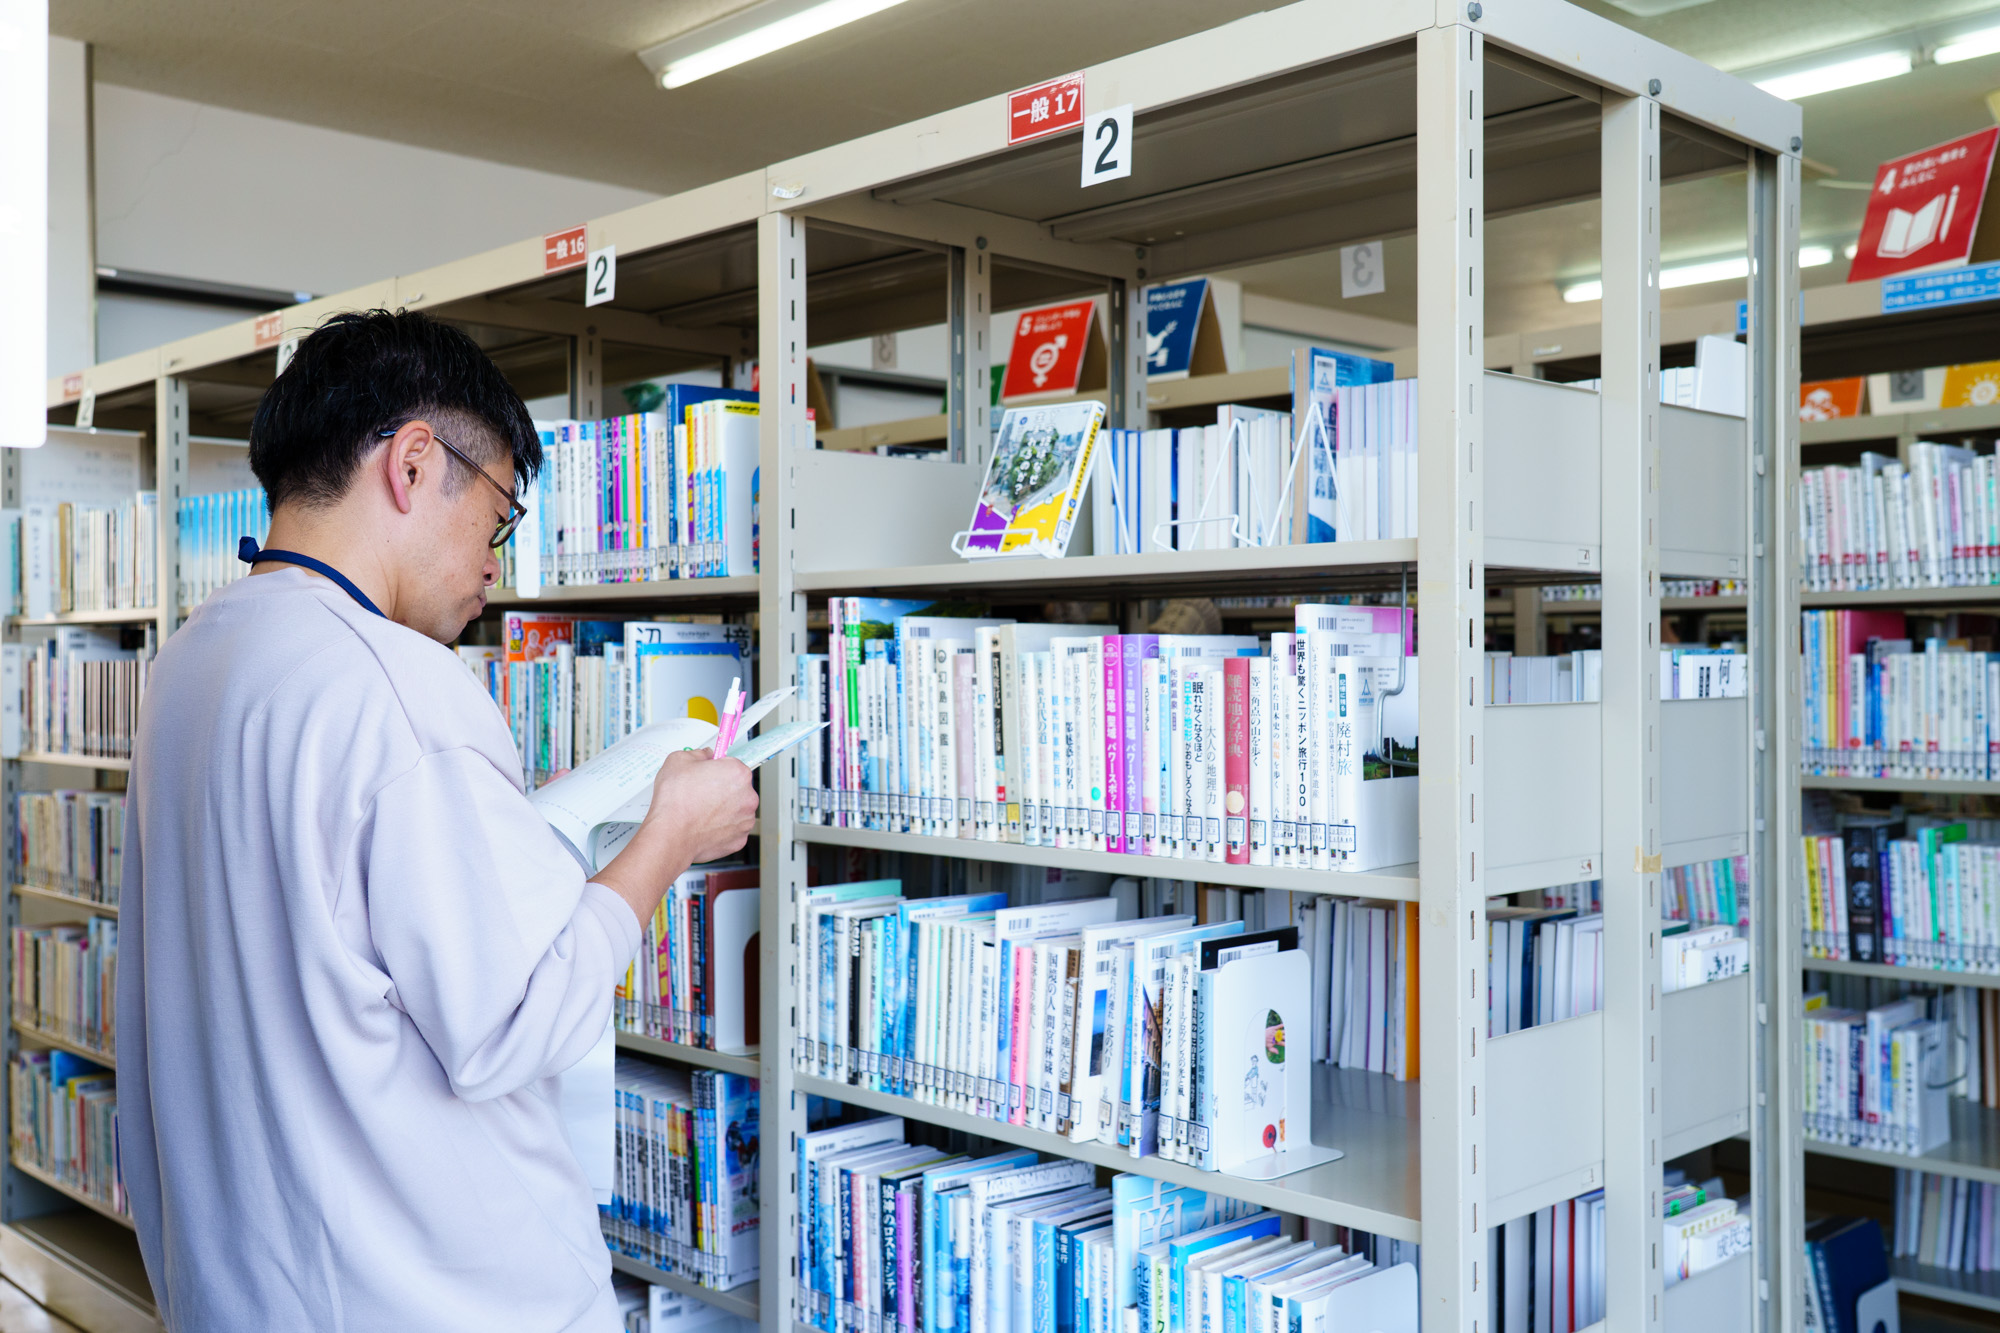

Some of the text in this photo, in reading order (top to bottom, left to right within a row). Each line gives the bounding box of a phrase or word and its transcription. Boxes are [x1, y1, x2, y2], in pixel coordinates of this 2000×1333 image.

[1013, 88, 1078, 124] 一般 17
[1094, 117, 1119, 174] 2
[1879, 167, 1897, 194] 4
[546, 236, 585, 260] 一般 16
[593, 254, 608, 296] 2
[1019, 316, 1033, 336] 5
[938, 670, 950, 747] 幻島図鑑
[1106, 689, 1117, 713] 聖地
[1125, 689, 1136, 713] 聖地
[1192, 681, 1204, 763] 眠れなくなるほど
[1227, 674, 1244, 758] 難読地名辞典
[1250, 670, 1261, 767] 一等三角点の山を歩く
[1296, 638, 1308, 806] 世界も驚くニッポン旅行100
[1107, 742, 1118, 812] パワースポット
[1126, 742, 1137, 812] パワースポット
[1205, 726, 1217, 805] 大人の地理力
[1336, 721, 1353, 776] 廃村旅
